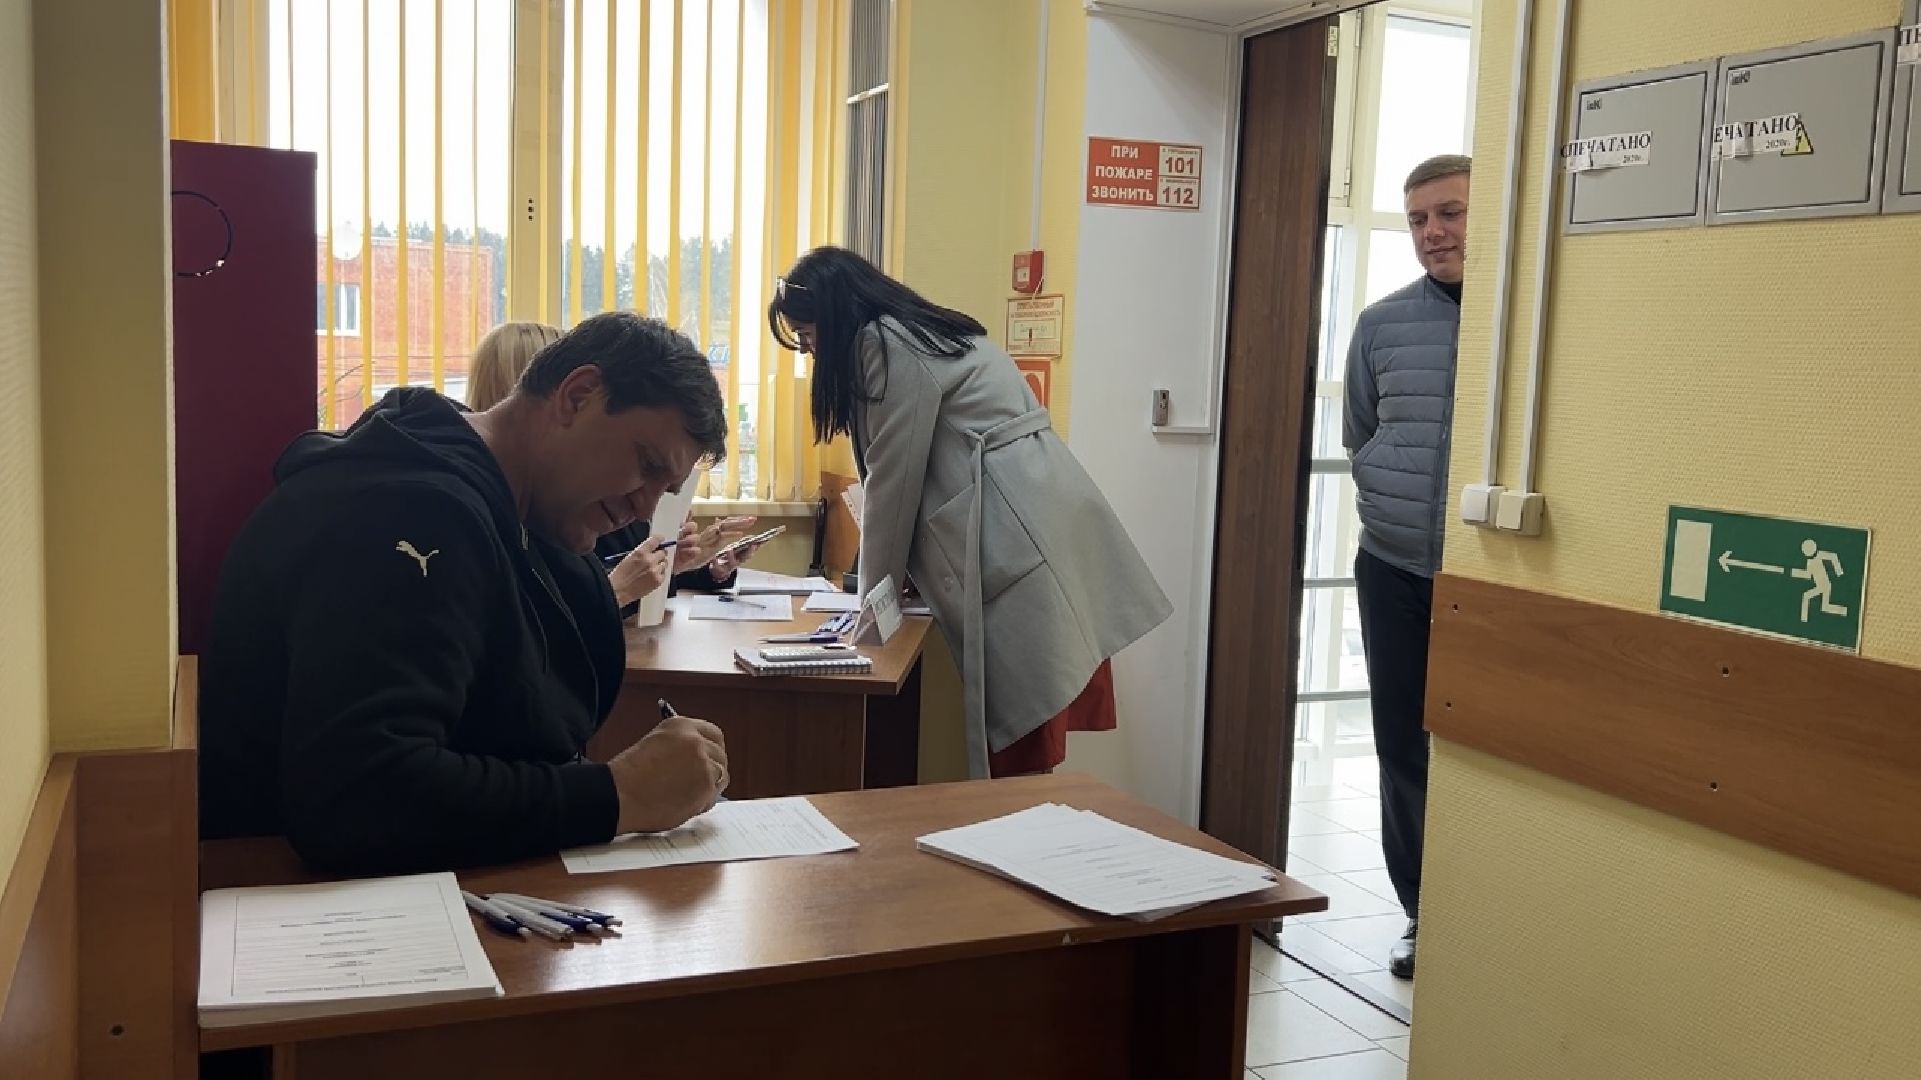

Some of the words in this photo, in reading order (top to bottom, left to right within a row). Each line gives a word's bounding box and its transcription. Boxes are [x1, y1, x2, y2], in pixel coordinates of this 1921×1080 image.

[1713, 114, 1798, 143] ЕЧАТАНО
[1111, 145, 1139, 159] ПРИ
[1095, 165, 1153, 180] ПОЖАРЕ
[1165, 157, 1194, 175] 101
[1092, 185, 1154, 201] ЗВОНИТЬ
[1162, 186, 1194, 205] 112
